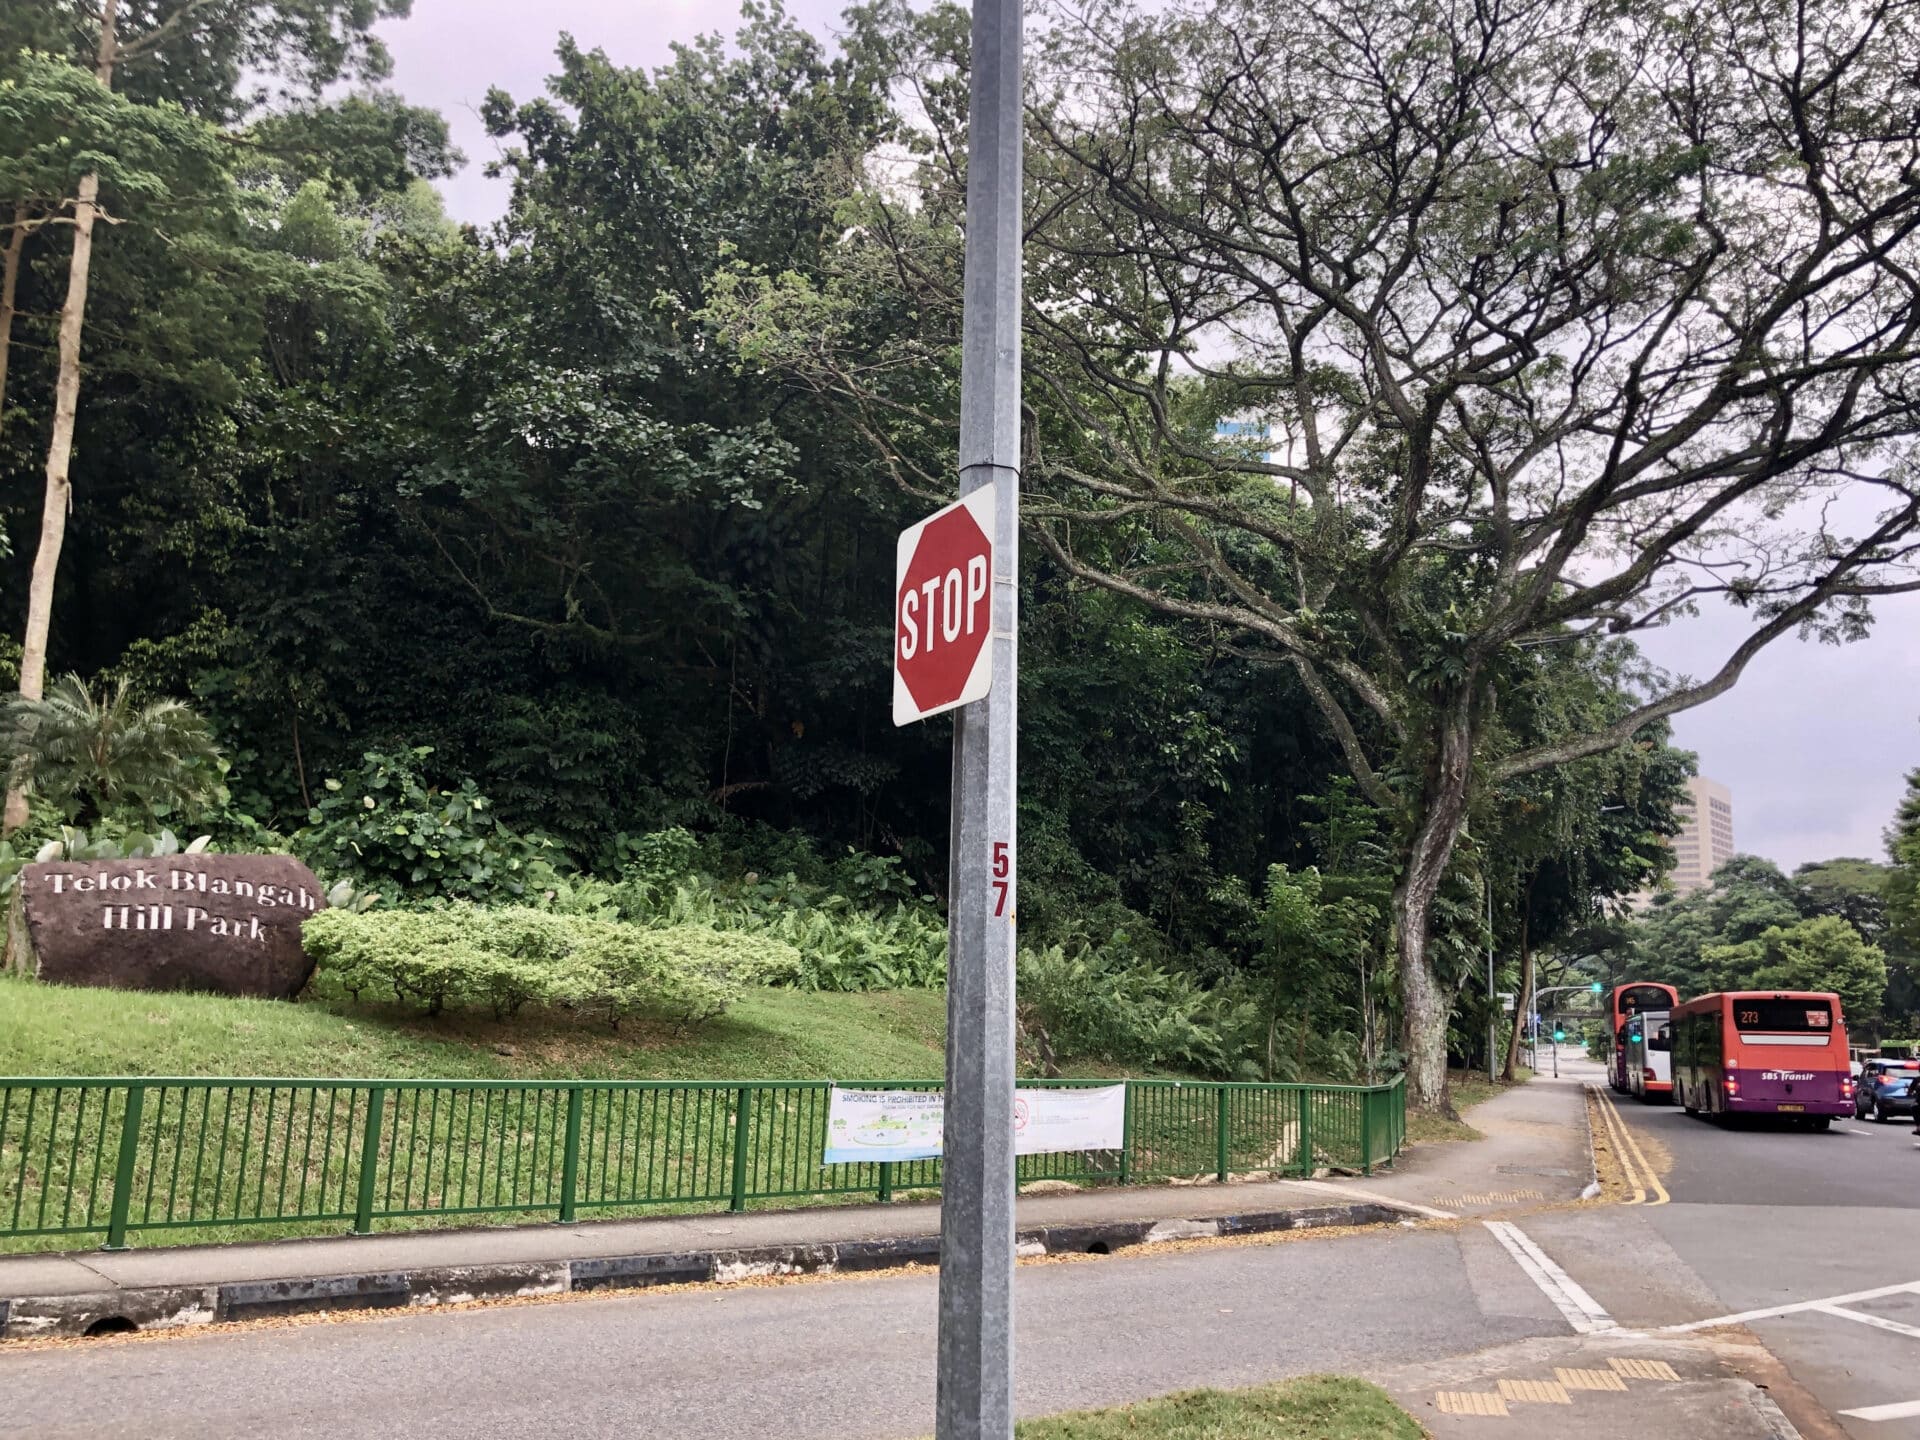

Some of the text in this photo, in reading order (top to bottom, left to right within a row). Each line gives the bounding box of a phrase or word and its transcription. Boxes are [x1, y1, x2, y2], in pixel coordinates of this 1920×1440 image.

[901, 554, 987, 660] STOP
[43, 869, 315, 911] Telok Blangah
[992, 841, 1009, 917] 57
[104, 904, 266, 942] Hill Park
[1741, 1011, 1759, 1024] 273
[1761, 1069, 1816, 1081] SBS Transit
[842, 1094, 877, 1103] SMOKING
[879, 1095, 886, 1103] IS
[888, 1096, 927, 1104] PROHIBITED
